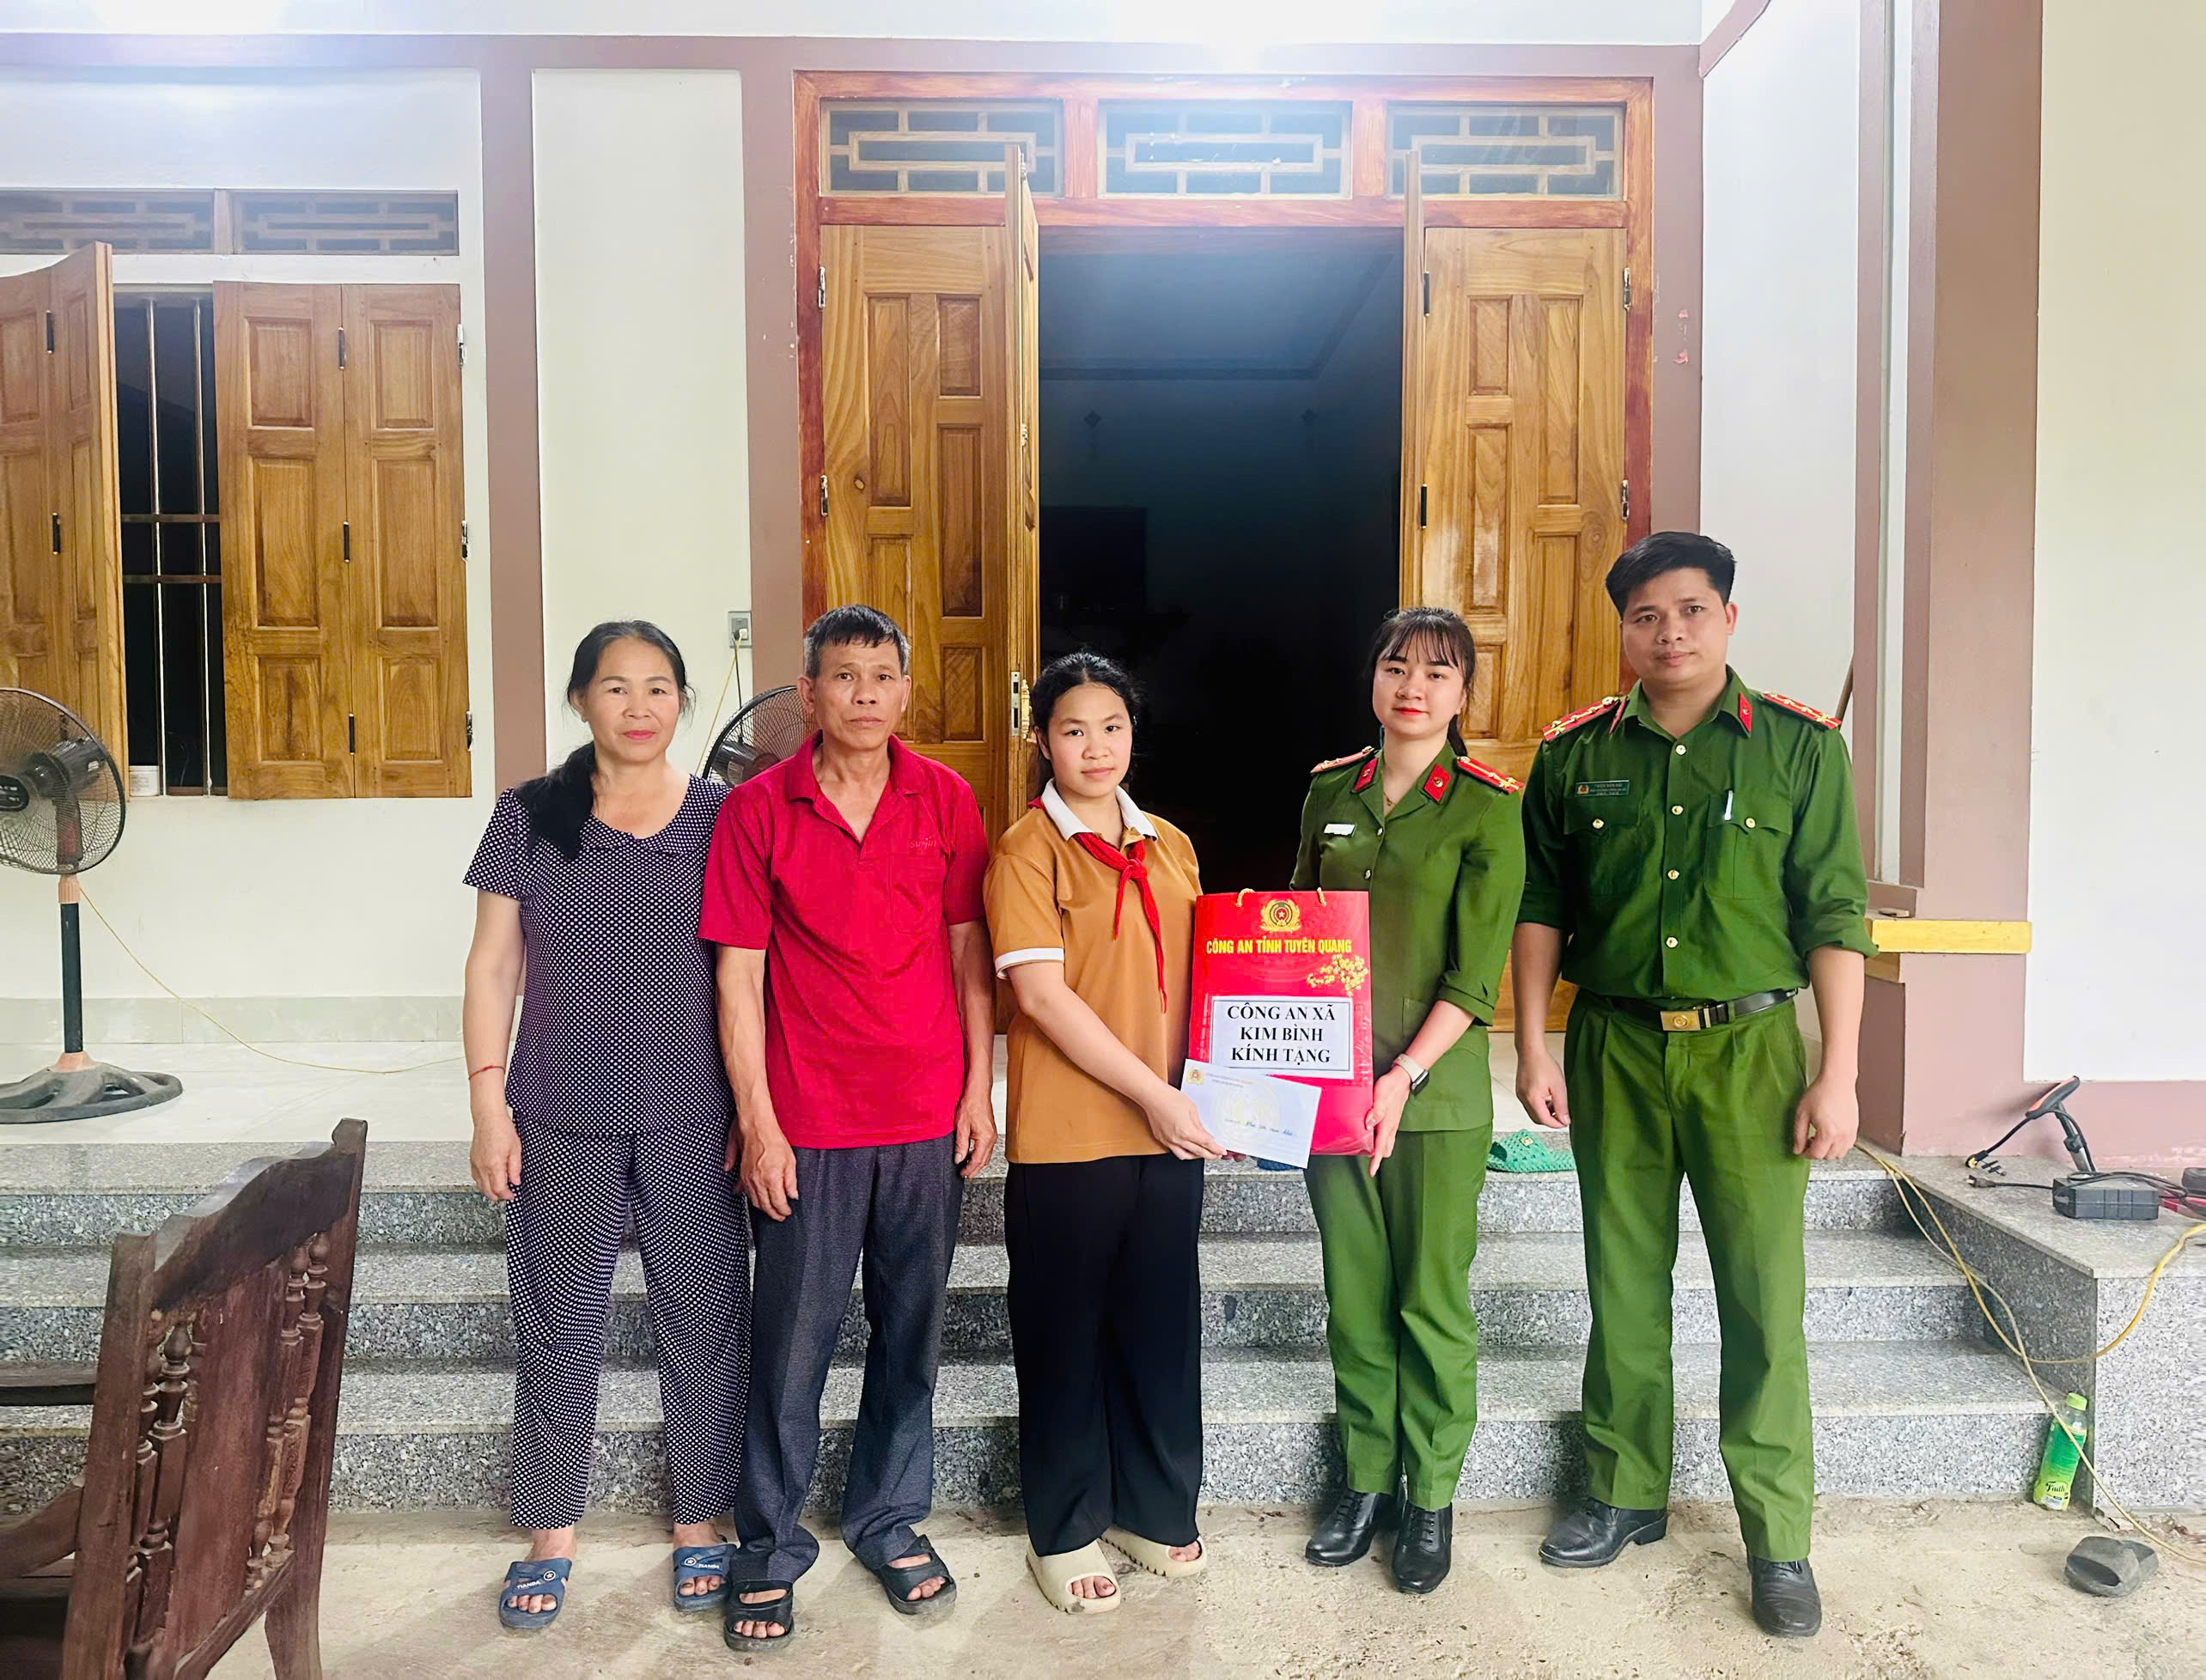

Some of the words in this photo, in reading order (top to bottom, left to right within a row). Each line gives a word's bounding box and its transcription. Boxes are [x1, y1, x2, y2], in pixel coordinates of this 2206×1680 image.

[1206, 938, 1234, 953] CÔNG
[1237, 940, 1252, 953] AN
[1256, 935, 1282, 953] TỈNH
[1284, 937, 1315, 953] TUYÊN
[1318, 940, 1351, 954] QUANG
[1228, 1002, 1281, 1020] CÔNG
[1285, 1007, 1308, 1020] AN
[1313, 1004, 1335, 1020] XÃ
[1240, 1026, 1277, 1040] KIM
[1283, 1024, 1324, 1042] BÌNH
[1231, 1044, 1277, 1062] KÍNH
